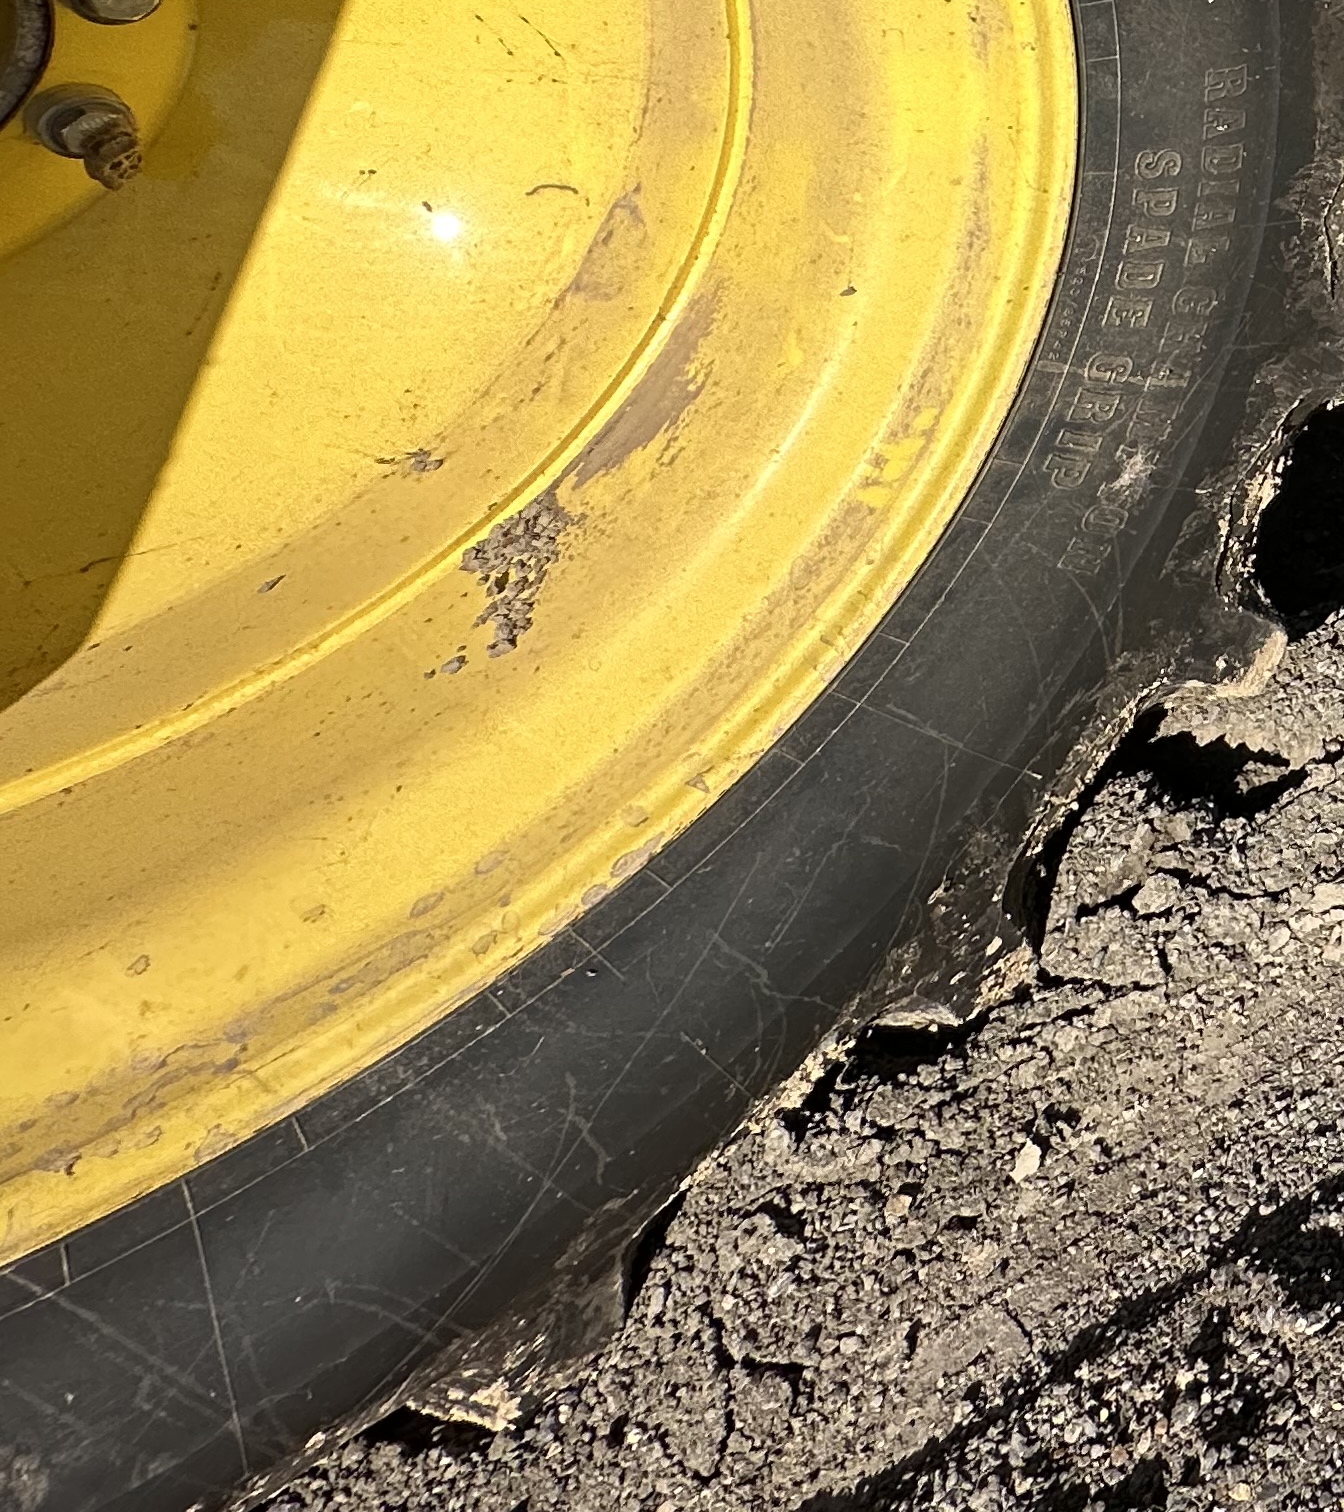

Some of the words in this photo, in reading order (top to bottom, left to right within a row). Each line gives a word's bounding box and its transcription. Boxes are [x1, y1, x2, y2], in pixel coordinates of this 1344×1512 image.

[1101, 149, 1184, 329] SPADE
[1184, 63, 1250, 266] RADIAL
[1041, 353, 1134, 491] GRIP
[1057, 287, 1217, 575] CHAMON
